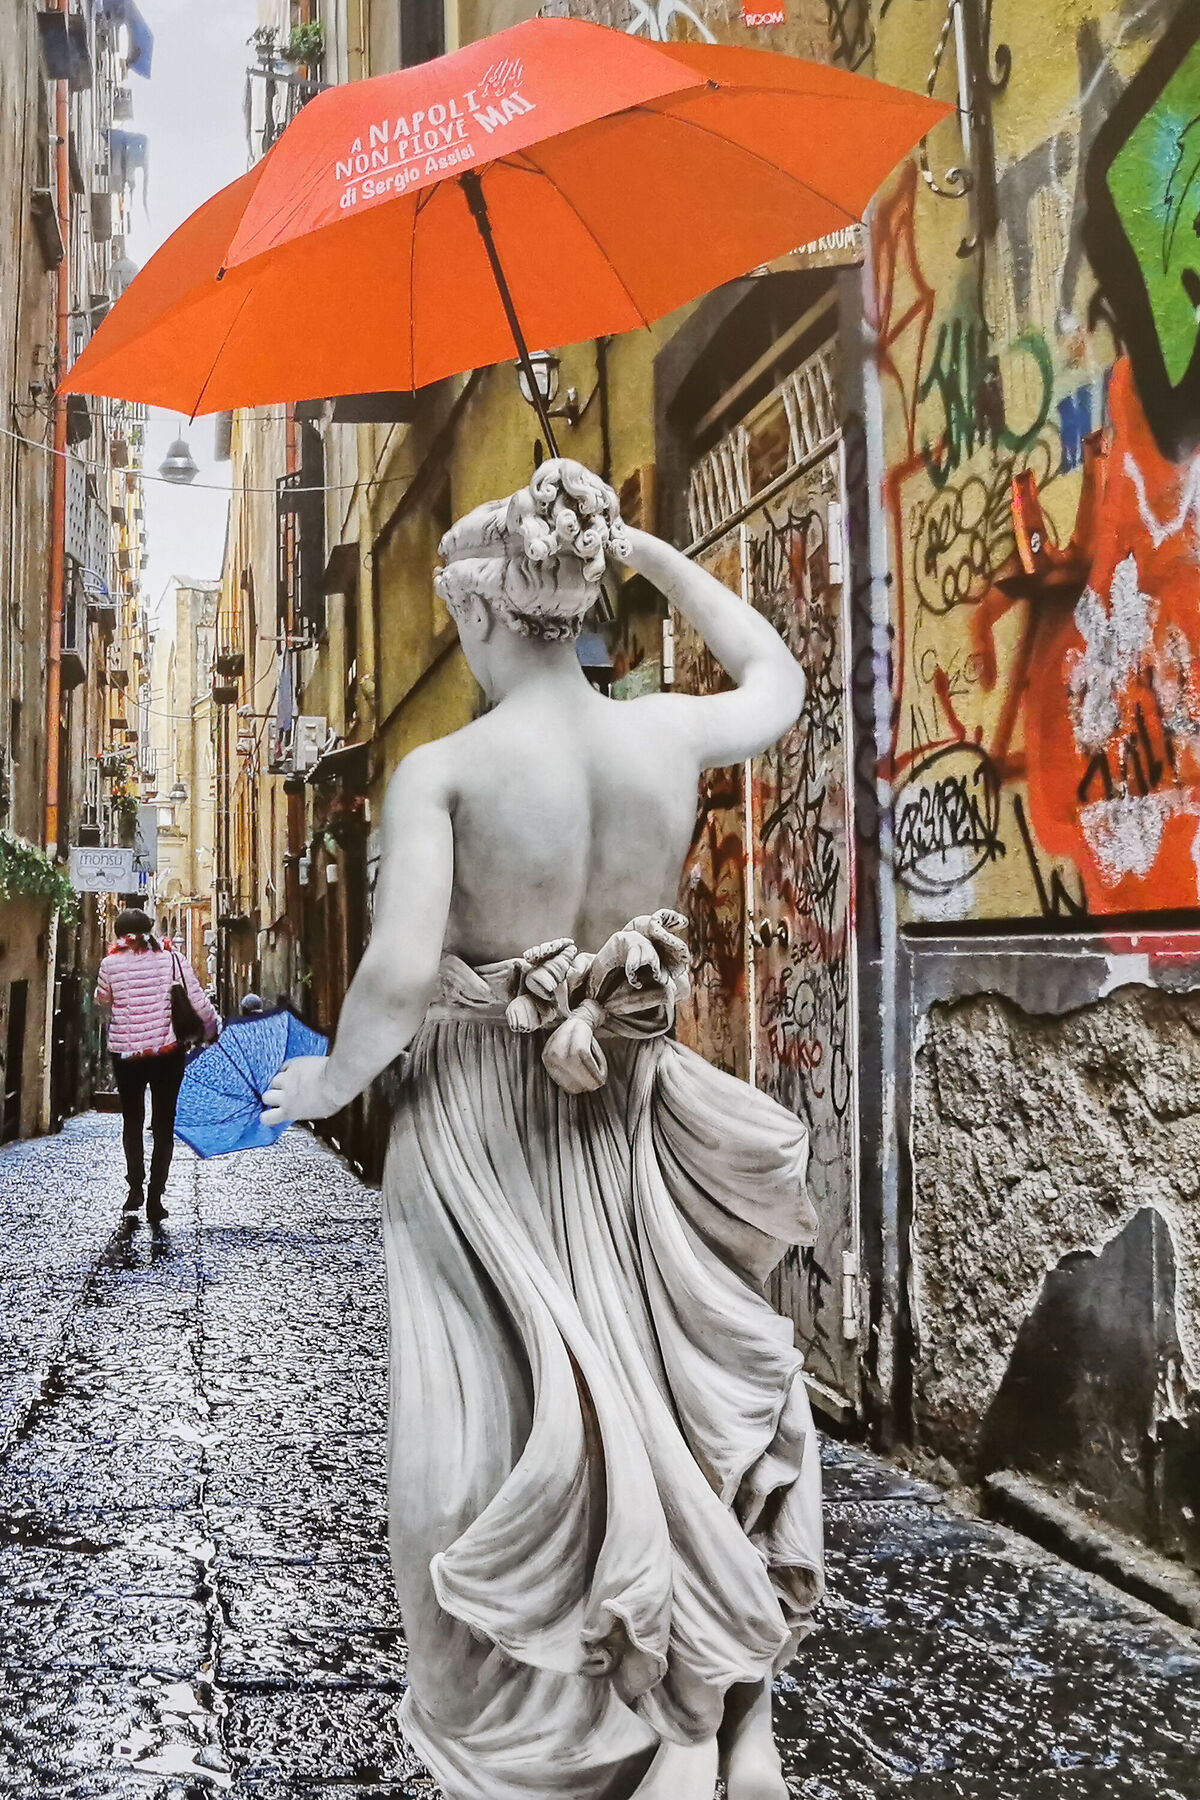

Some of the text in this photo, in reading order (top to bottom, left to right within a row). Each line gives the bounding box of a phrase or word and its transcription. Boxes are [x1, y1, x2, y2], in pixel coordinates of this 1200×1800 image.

[335, 91, 536, 181] NON PIOVE MAI
[351, 90, 481, 154] A NAPOLI
[339, 143, 476, 209] di Sergio Assisi
